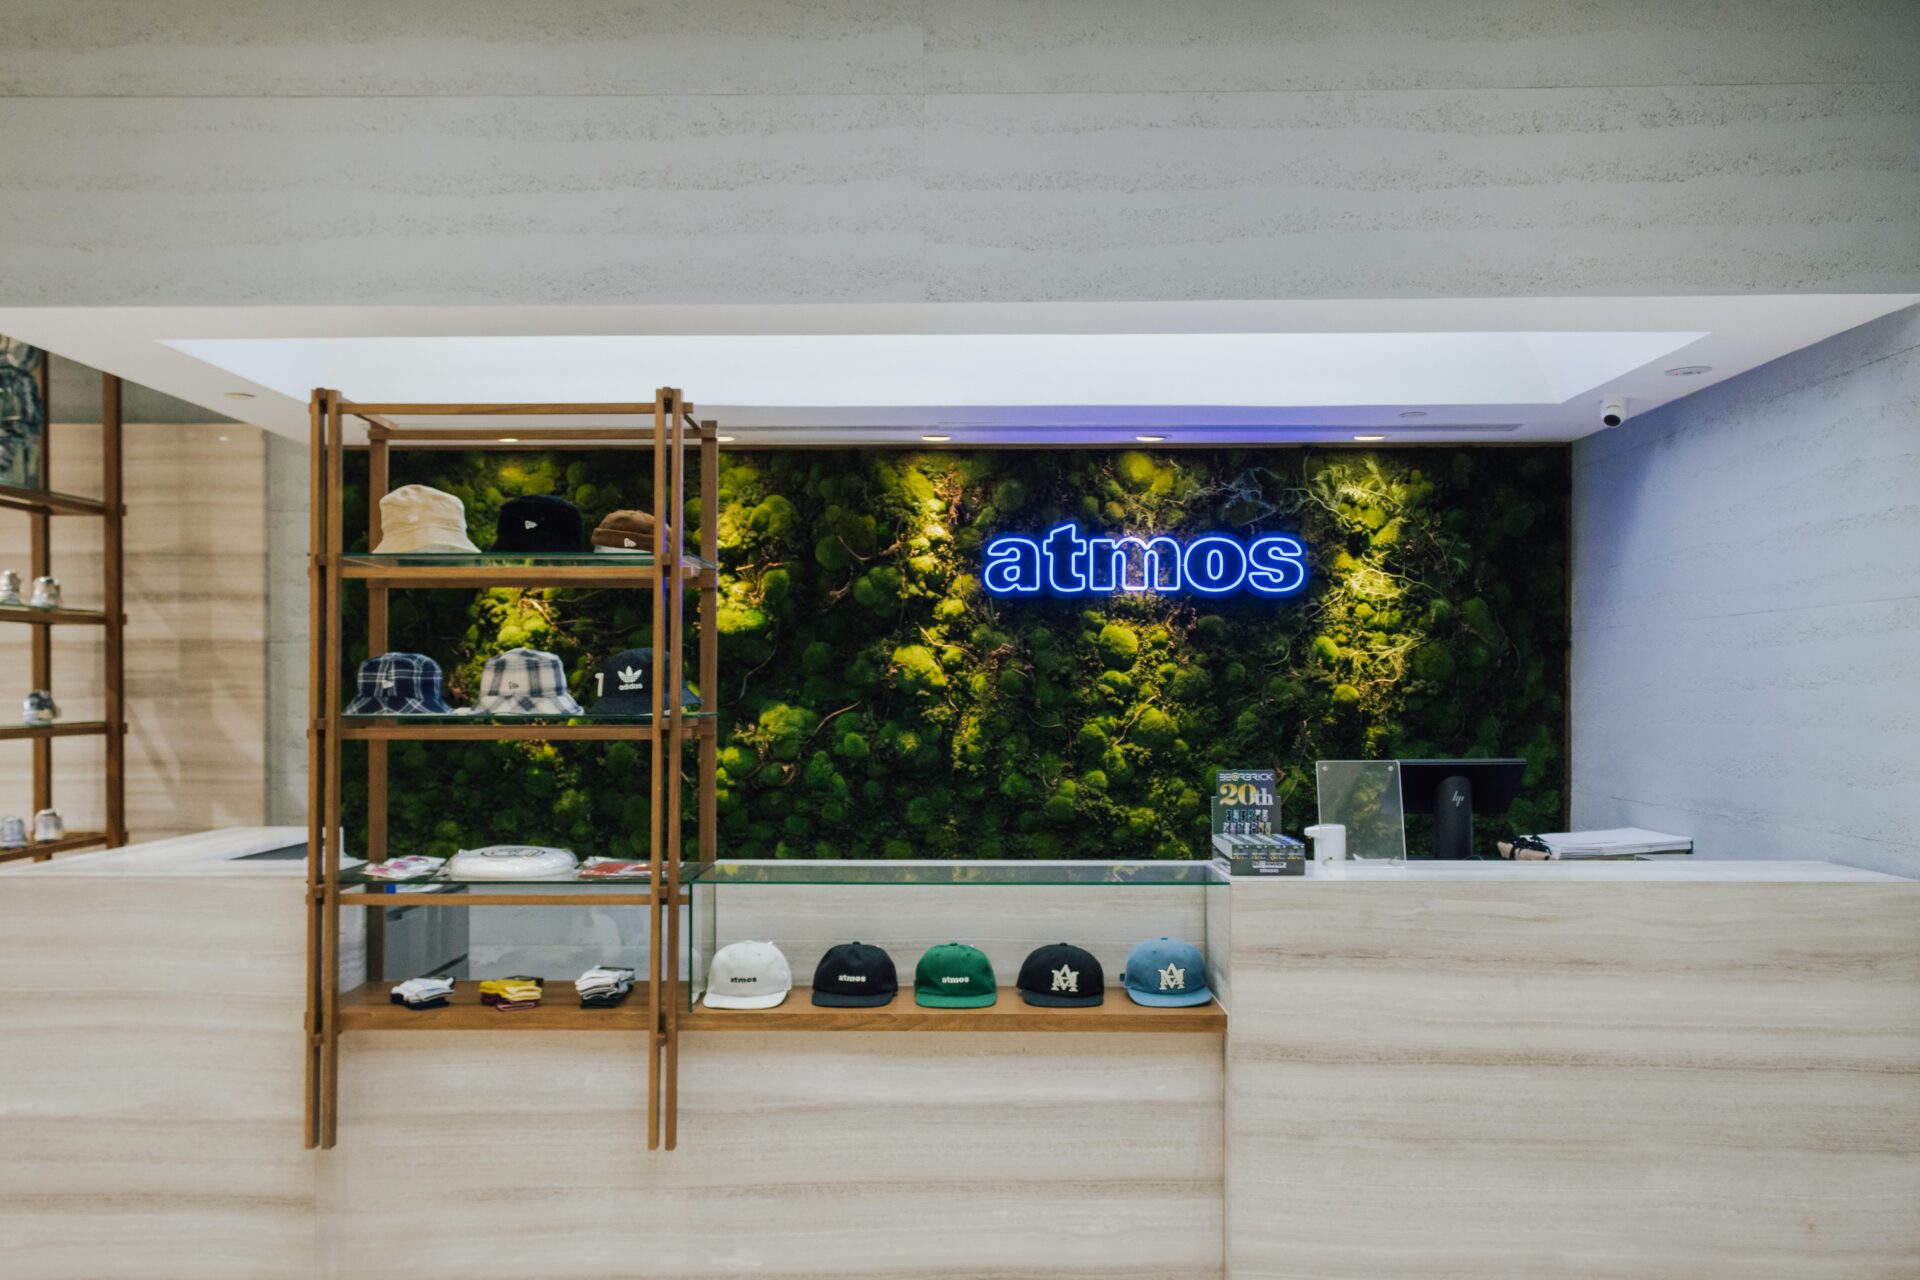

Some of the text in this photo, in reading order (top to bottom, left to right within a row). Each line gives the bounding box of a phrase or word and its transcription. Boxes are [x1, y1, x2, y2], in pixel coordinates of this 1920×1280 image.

[984, 523, 1304, 592] atmos
[618, 683, 643, 691] adidas
[1220, 783, 1273, 806] 20th
[1451, 790, 1465, 807] hp
[838, 974, 866, 983] atmos
[941, 975, 970, 984] atmos
